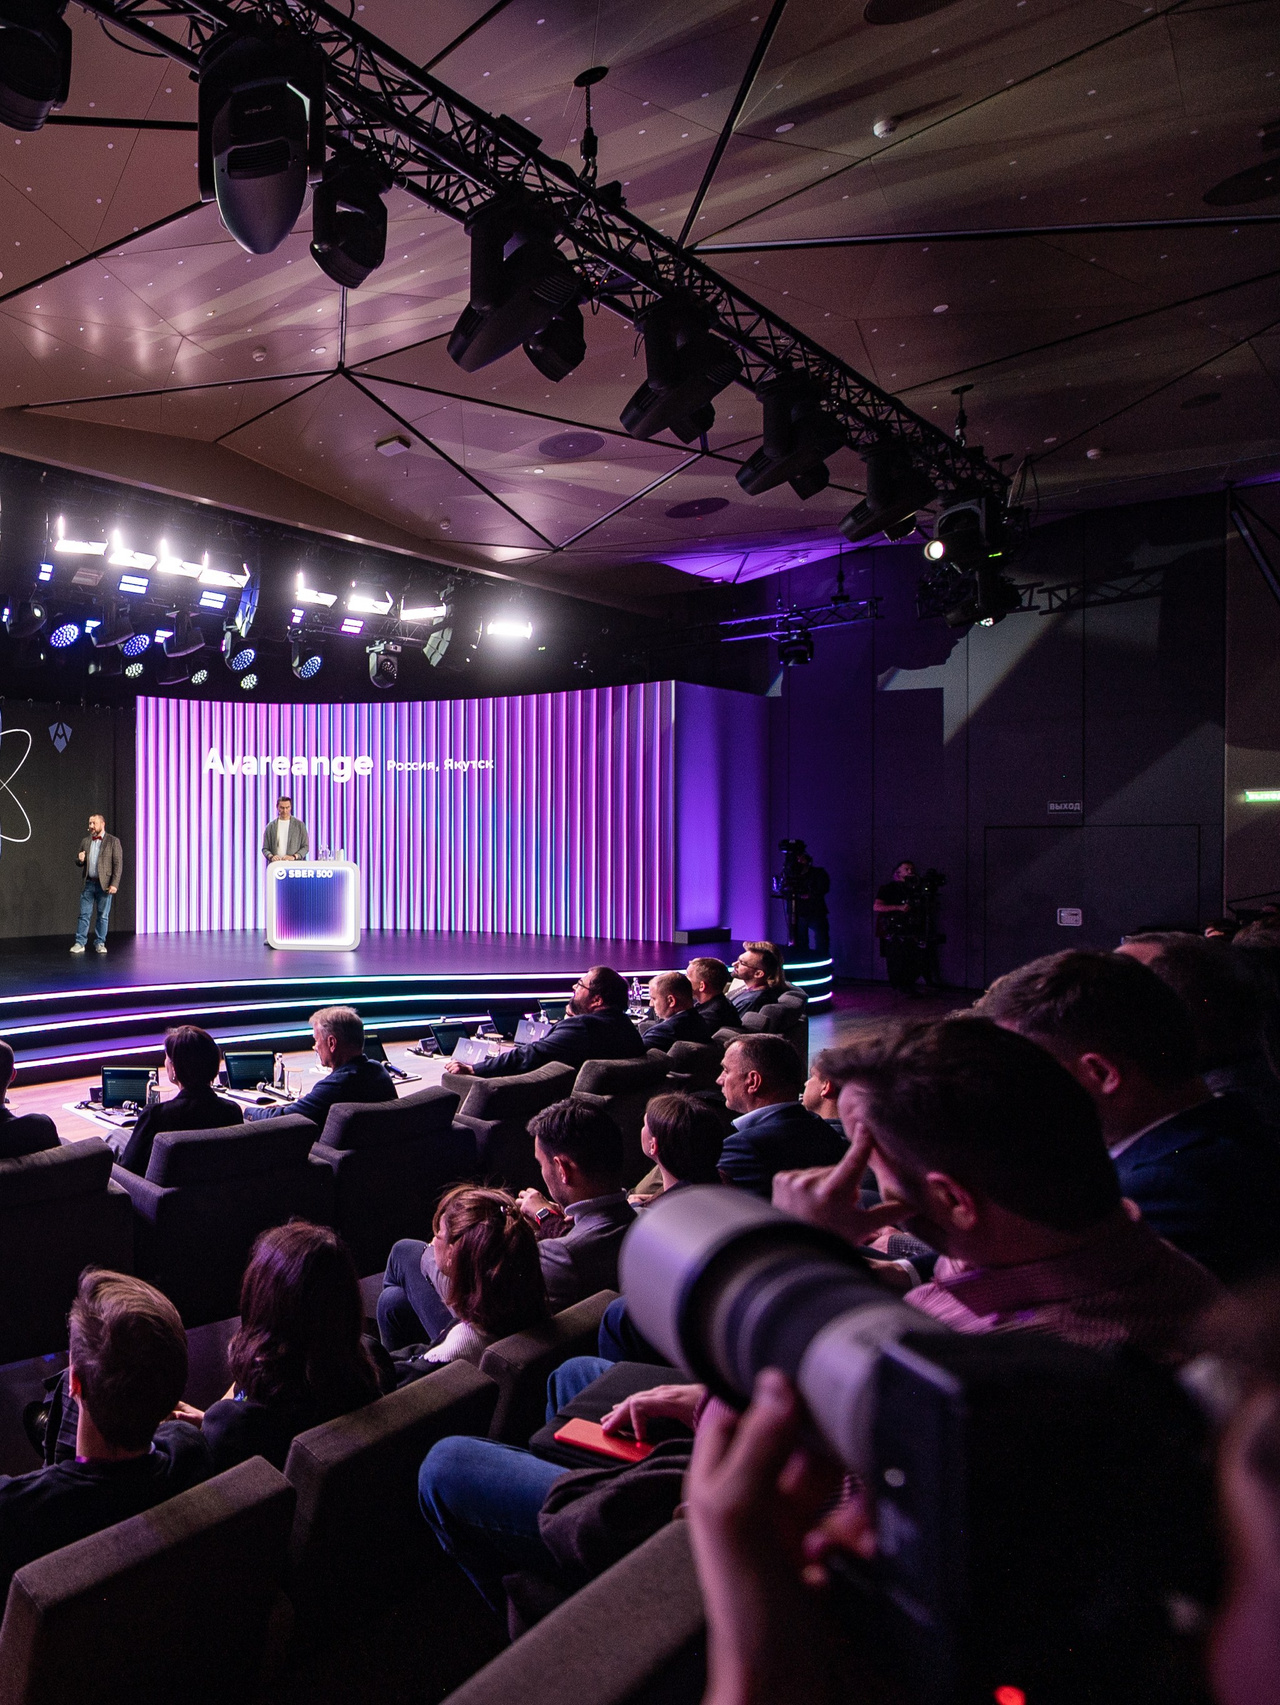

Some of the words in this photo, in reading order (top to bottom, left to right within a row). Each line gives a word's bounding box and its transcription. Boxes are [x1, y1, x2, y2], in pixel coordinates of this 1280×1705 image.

[202, 747, 374, 783] Avareange
[386, 759, 440, 772] Россия,
[443, 758, 495, 771] Якутск
[1049, 802, 1081, 811] ВЫХОД
[288, 869, 314, 878] SBER
[316, 869, 333, 878] 500
